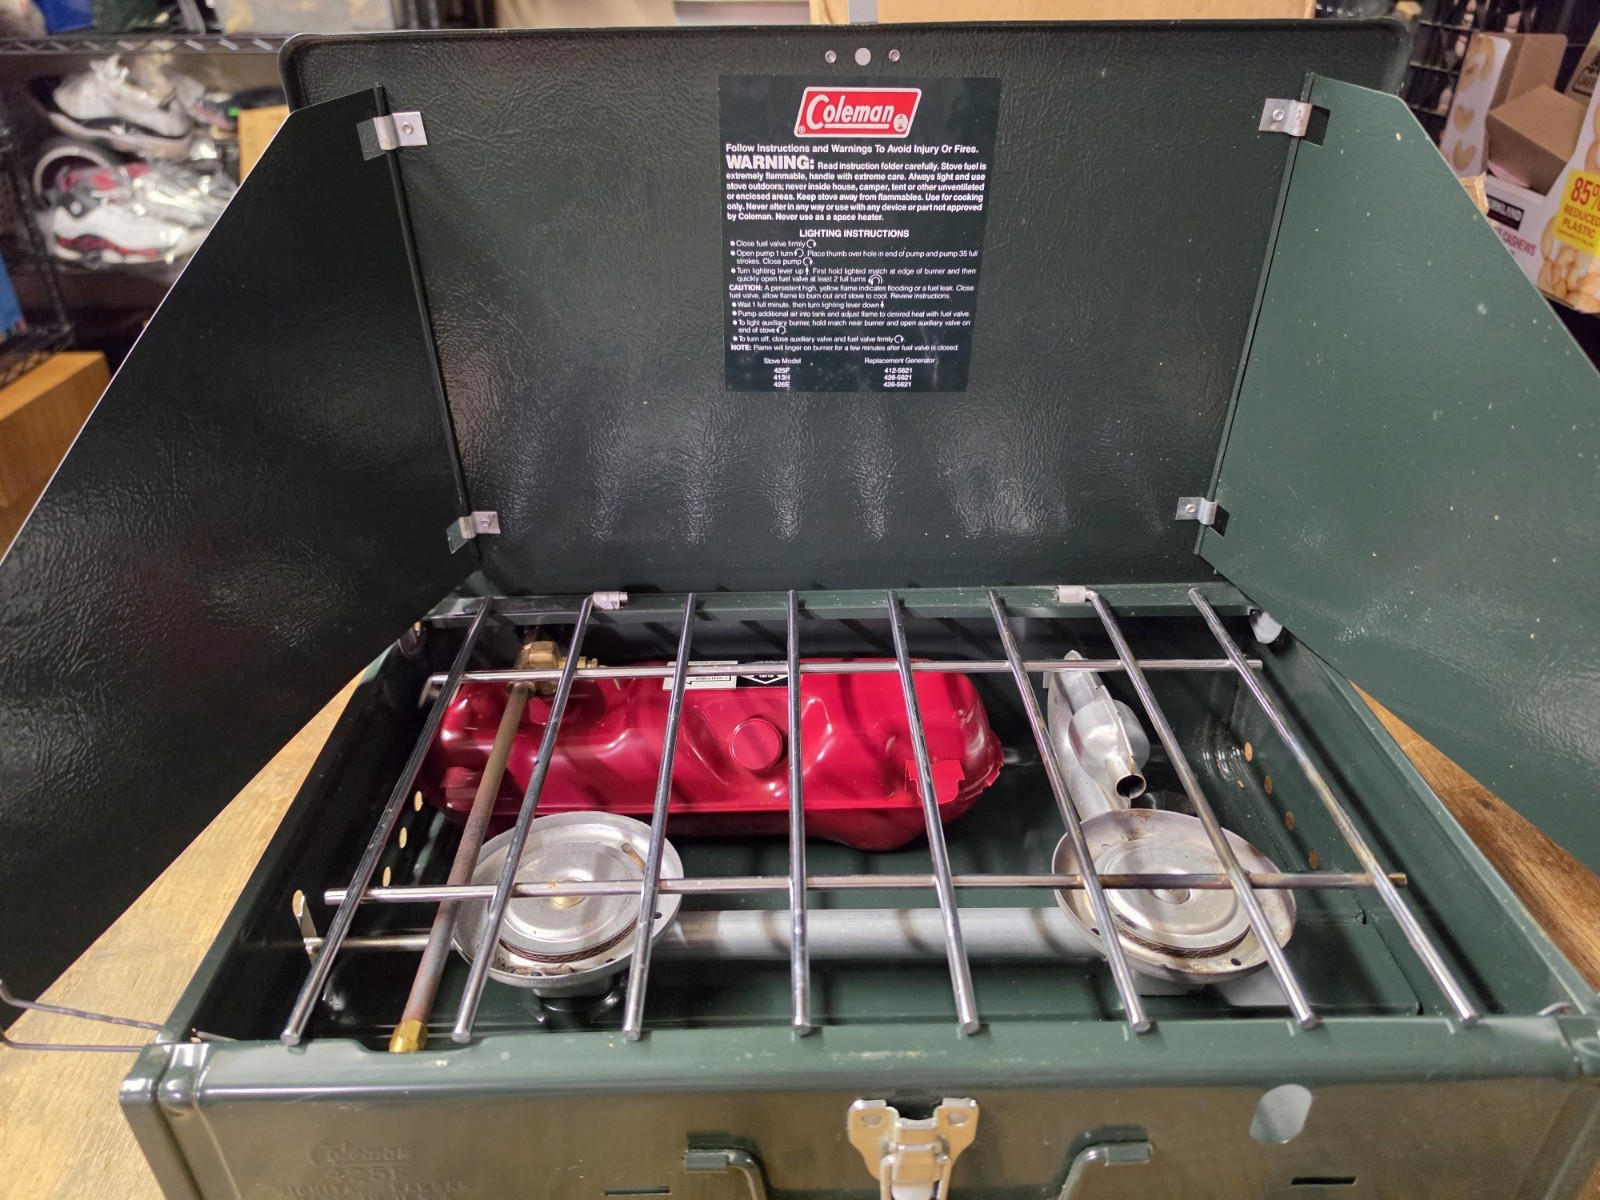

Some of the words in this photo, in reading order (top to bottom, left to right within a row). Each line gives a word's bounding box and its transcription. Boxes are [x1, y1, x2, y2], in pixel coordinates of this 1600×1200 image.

[806, 94, 894, 130] Coleman
[726, 143, 755, 152] Follow
[757, 144, 810, 152] Instructions
[812, 144, 829, 153] and
[831, 144, 872, 155] Warnings
[875, 144, 885, 153] To
[887, 144, 912, 153] Avoid
[914, 144, 939, 155] Injury
[941, 144, 952, 153] Or
[954, 144, 978, 153] Fires.
[726, 155, 814, 170] WARNING:
[818, 162, 838, 170] Read
[839, 162, 880, 170] instruction
[881, 162, 904, 170] folder
[904, 162, 939, 172] carefully.
[941, 162, 963, 170] Stove
[964, 162, 979, 170] fuel
[726, 172, 764, 181] extremely
[765, 172, 807, 180] flammable,
[809, 172, 835, 180] handle
[837, 172, 853, 180] with
[908, 173, 935, 181] Always
[937, 173, 954, 181] light
[726, 182, 747, 190] stove
[748, 182, 784, 191] outdoors;
[832, 183, 858, 191] house,
[859, 184, 890, 192] camper,
[892, 183, 907, 191] tent
[917, 183, 937, 191] other
[938, 183, 985, 191] unventilated
[736, 192, 771, 200] enclosed
[796, 193, 816, 202] Keep
[839, 194, 858, 202] away
[859, 193, 877, 201] from
[878, 193, 923, 201] flammables.
[925, 193, 940, 201] Use
[942, 193, 952, 201] for
[953, 194, 983, 202] cooking
[727, 202, 745, 212] only.
[746, 202, 768, 210] Never
[795, 204, 809, 212] any
[810, 204, 825, 212] way
[850, 203, 866, 211] with
[867, 204, 881, 212] any
[881, 203, 907, 211] device
[917, 204, 933, 212] part
[947, 203, 982, 212] approved
[727, 212, 737, 221] by
[738, 212, 773, 220] Coleman.
[833, 214, 856, 222] space
[858, 213, 884, 221] heater.
[1562, 217, 1596, 239] PLASTIC
[800, 229, 842, 237] LIGHTING
[844, 230, 909, 238] INSTRUCTIONS
[1501, 231, 1537, 257] CASHEWS
